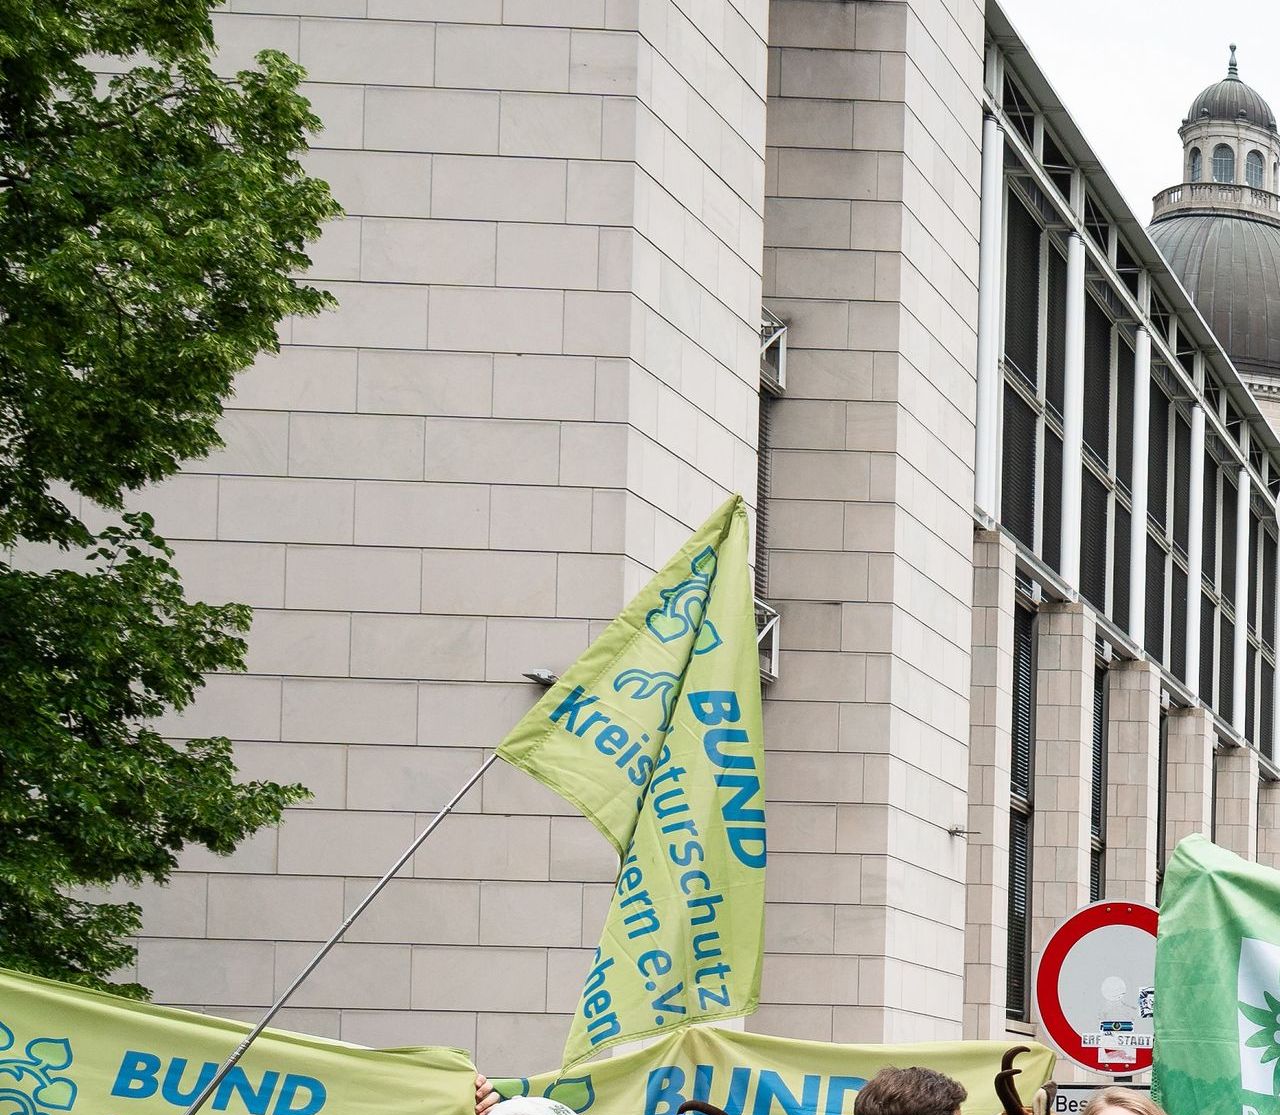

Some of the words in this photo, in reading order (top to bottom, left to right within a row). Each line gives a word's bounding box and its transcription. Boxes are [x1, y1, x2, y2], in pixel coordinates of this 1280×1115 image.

[549, 685, 655, 788] Kreis
[688, 690, 767, 869] BUND
[650, 735, 732, 1011] aturschutz
[637, 948, 687, 1026] e.V.
[1056, 1095, 1088, 1113] Bes
